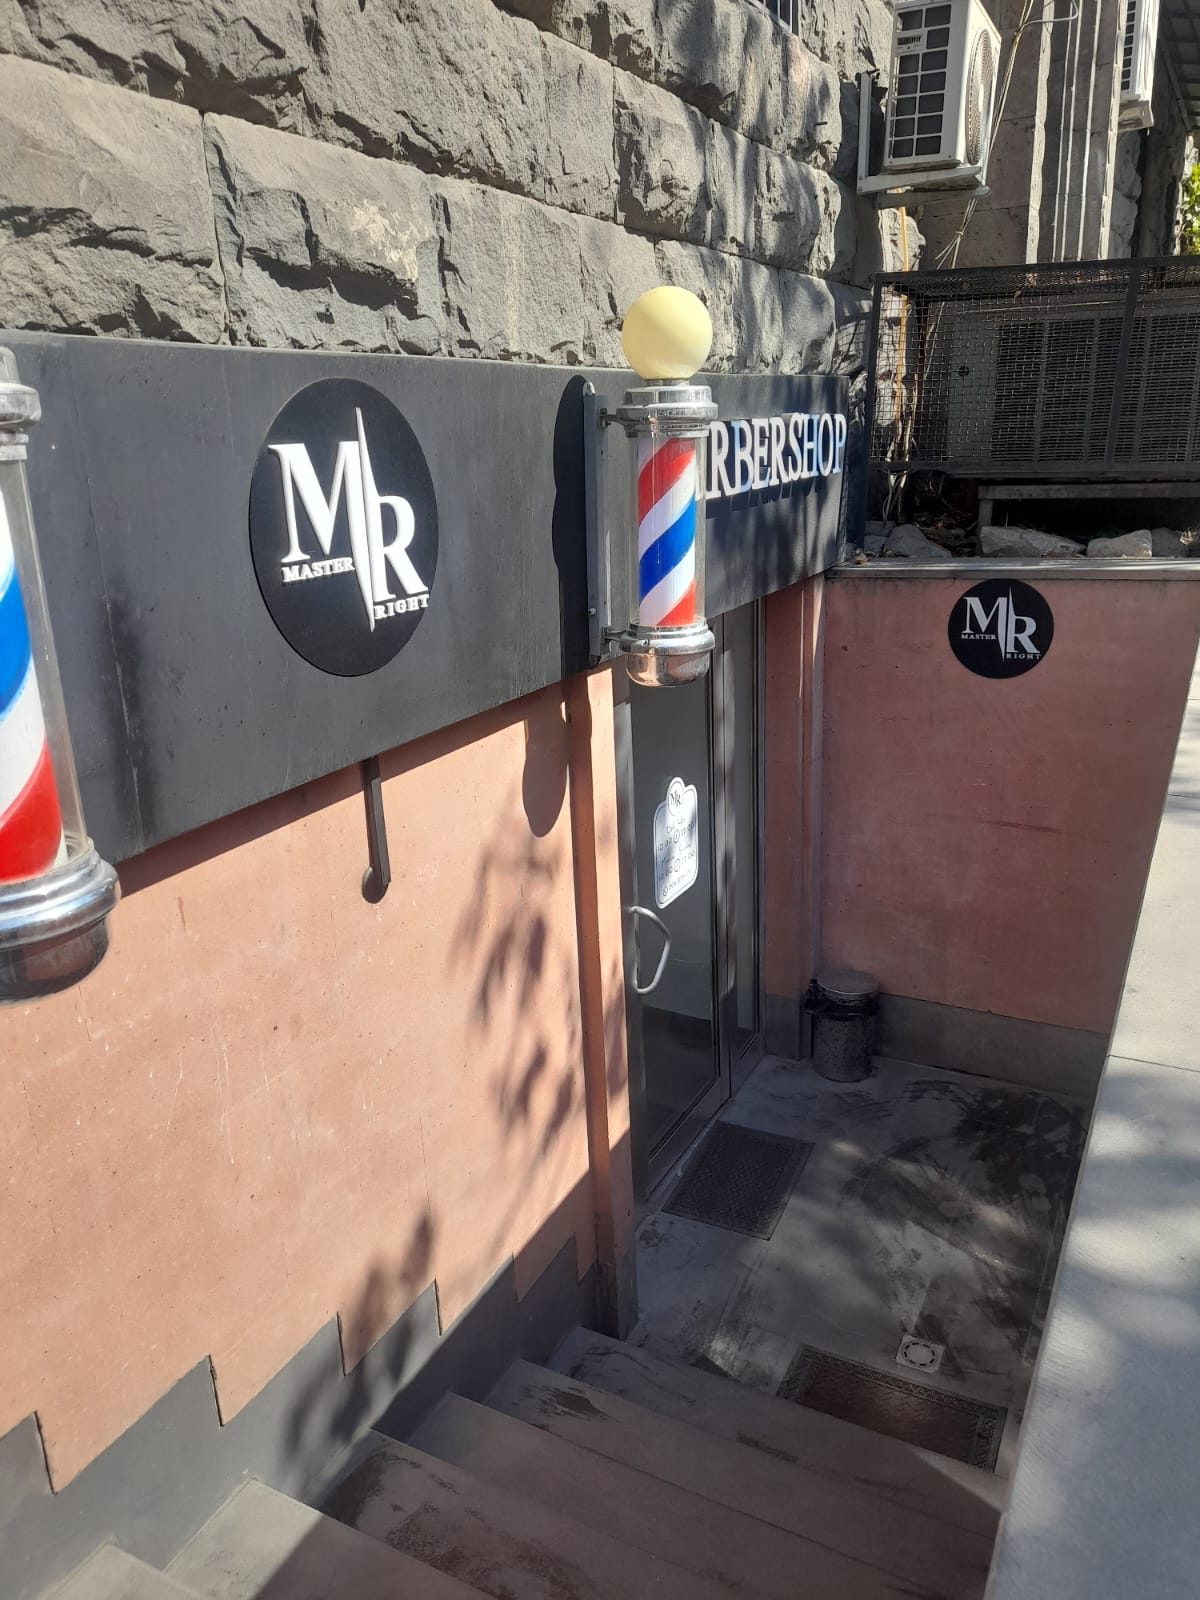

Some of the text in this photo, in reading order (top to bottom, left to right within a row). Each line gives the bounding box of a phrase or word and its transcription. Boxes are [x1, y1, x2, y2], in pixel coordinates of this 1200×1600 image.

[695, 412, 847, 500] RBERSHOP
[281, 557, 355, 583] MASTER
[374, 594, 430, 619] RIGHT
